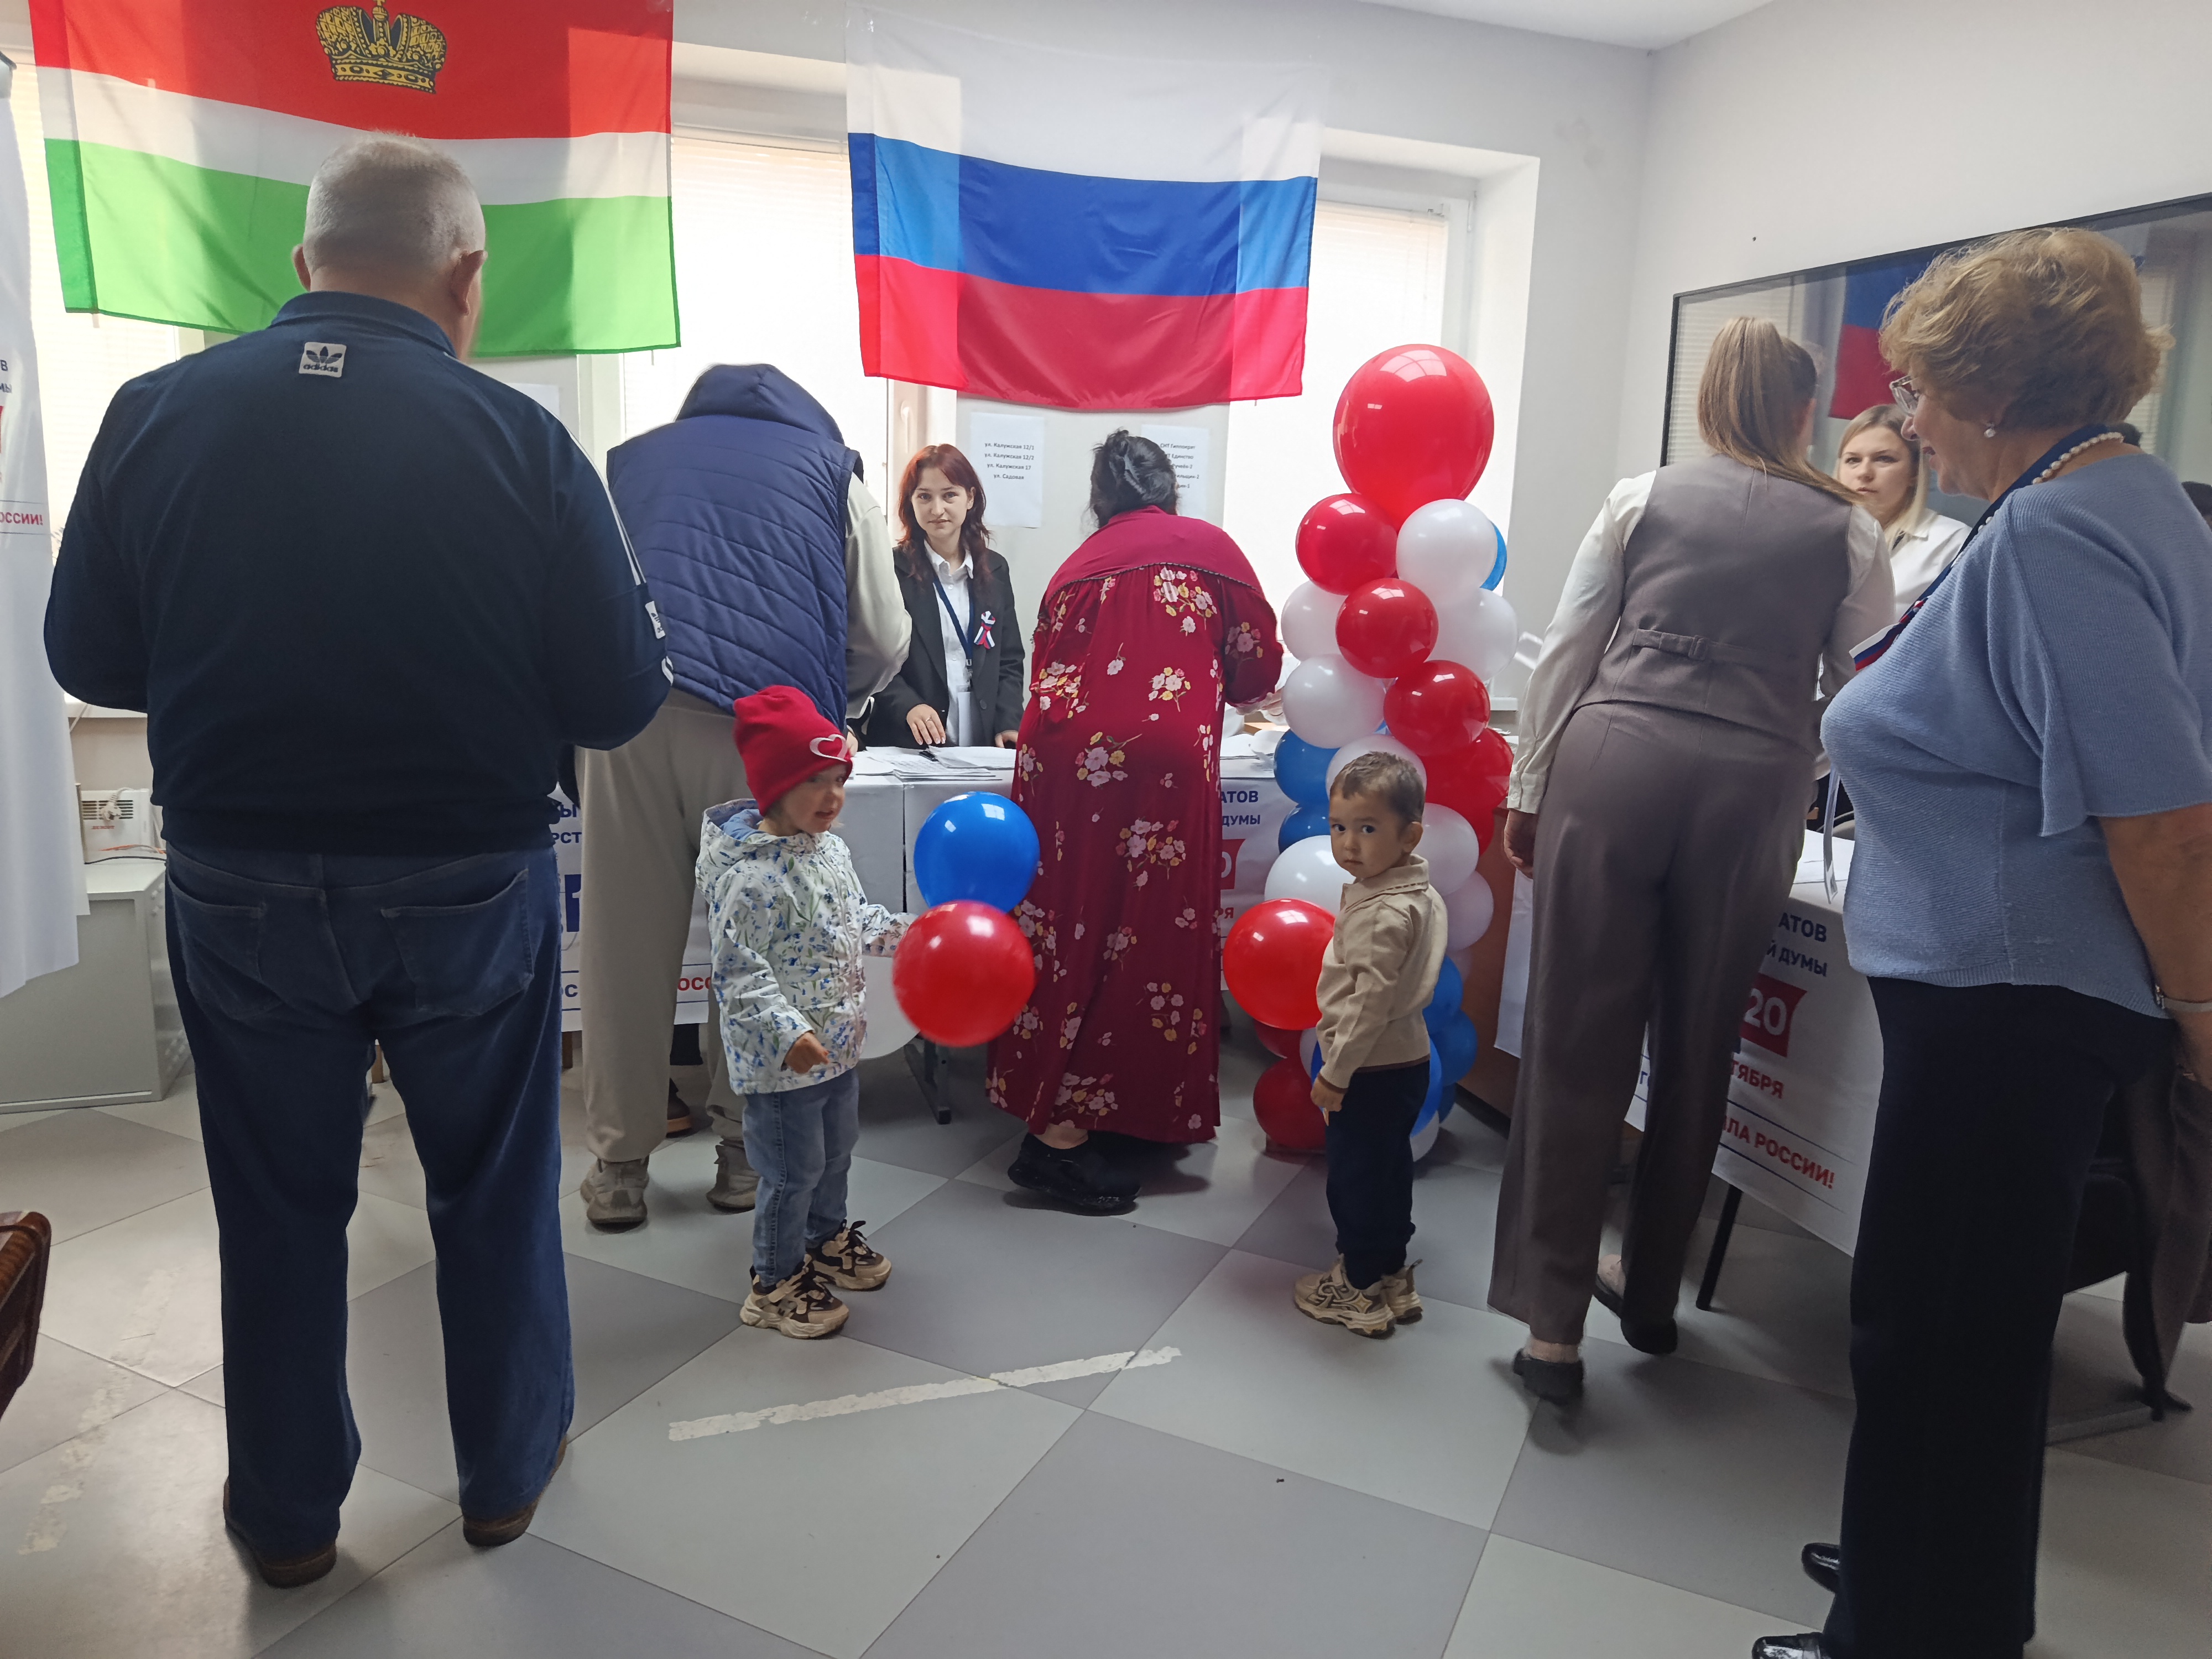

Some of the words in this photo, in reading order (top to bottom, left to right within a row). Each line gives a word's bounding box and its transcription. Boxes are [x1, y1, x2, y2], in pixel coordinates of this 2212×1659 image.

[303, 363, 338, 373] adidas
[0, 512, 43, 525] ОССИИ!
[1221, 790, 1259, 804] АТОВ
[1222, 815, 1260, 827] ДУМЫ
[552, 832, 582, 844] РСТ
[1778, 912, 1827, 943] АТОВ
[1778, 947, 1828, 977] ДУМЫ
[1744, 988, 1787, 1036] 20
[1731, 1060, 1785, 1099] ТЯБРЯ
[1754, 1132, 1835, 1190] РОССИИ!
